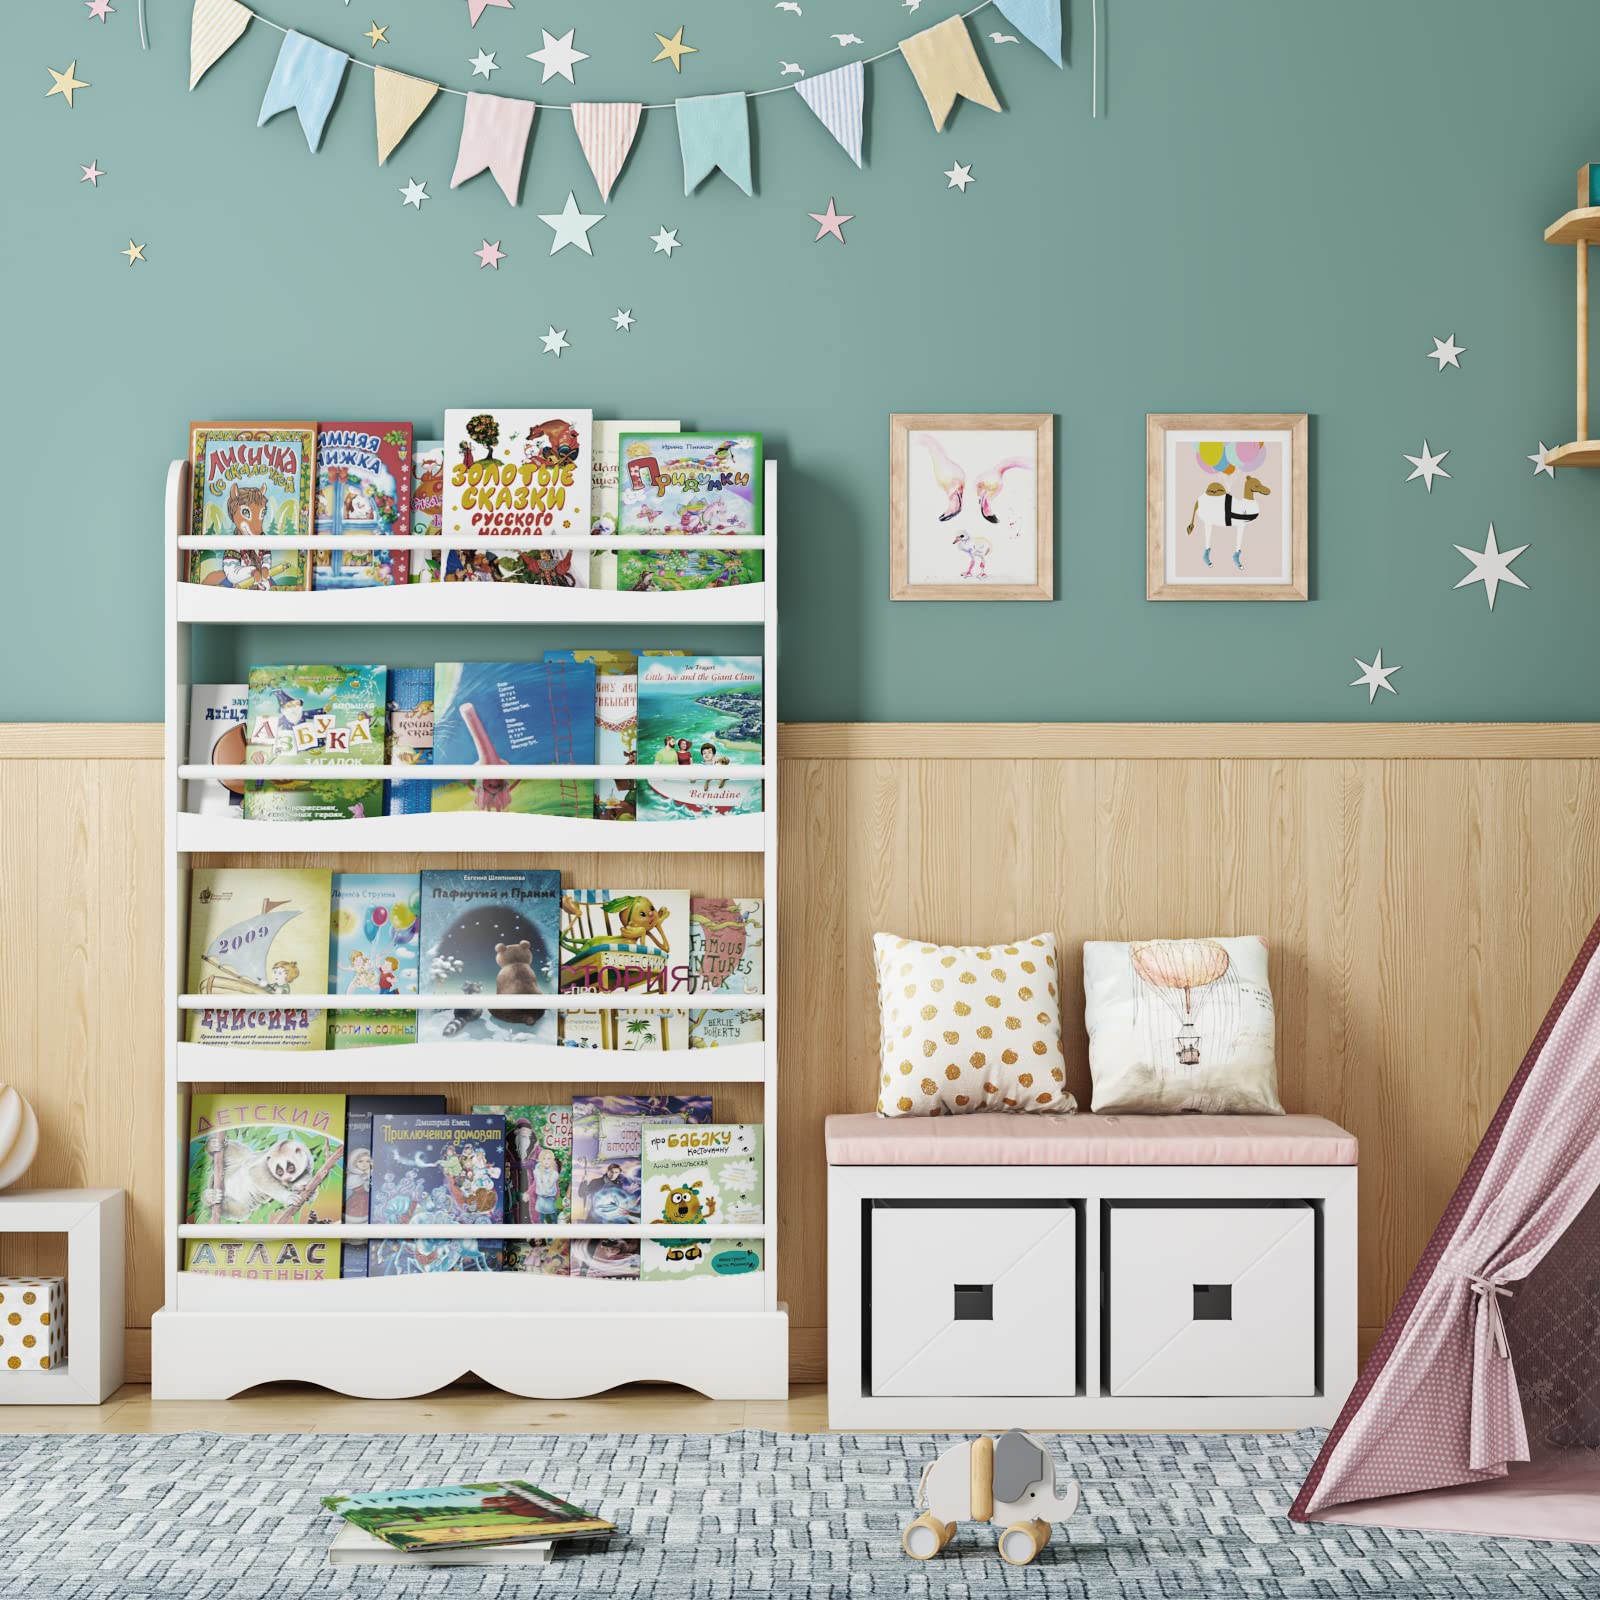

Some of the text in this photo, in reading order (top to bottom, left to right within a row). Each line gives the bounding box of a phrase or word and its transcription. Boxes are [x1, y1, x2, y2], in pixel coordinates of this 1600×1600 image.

[317, 431, 380, 452] ИМНЯЯ
[451, 463, 577, 487] ЗОЛОТЫЕ
[461, 486, 566, 512] СКАЗКИ
[471, 512, 553, 527] РУССКОГО
[645, 672, 755, 681] Little Joe and the Giant Clam
[689, 788, 741, 799] Bernadine
[432, 887, 498, 902] Пафнутий
[511, 887, 556, 902] Пряник
[219, 926, 269, 955] 2009
[690, 933, 743, 955] FAMOUS
[689, 955, 753, 975] NTURES
[560, 965, 689, 992] СТОРИЯ
[689, 975, 730, 994] JACK
[328, 1024, 361, 1035] ГОСТИ
[376, 1024, 416, 1035] СОЛНЫ
[708, 1018, 734, 1027] BERLIE
[197, 1104, 331, 1134] ДЕТСКИЙ
[549, 1112, 557, 1124] С
[383, 1125, 452, 1144] Приключения
[453, 1129, 502, 1146] домовят
[556, 1125, 572, 1136] год
[546, 1134, 572, 1147] Снег
[607, 1142, 641, 1152] второг
[651, 1136, 666, 1151] про
[192, 1242, 327, 1265] АТЛАС
[191, 1268, 325, 1280] ИВОТНЫХ
